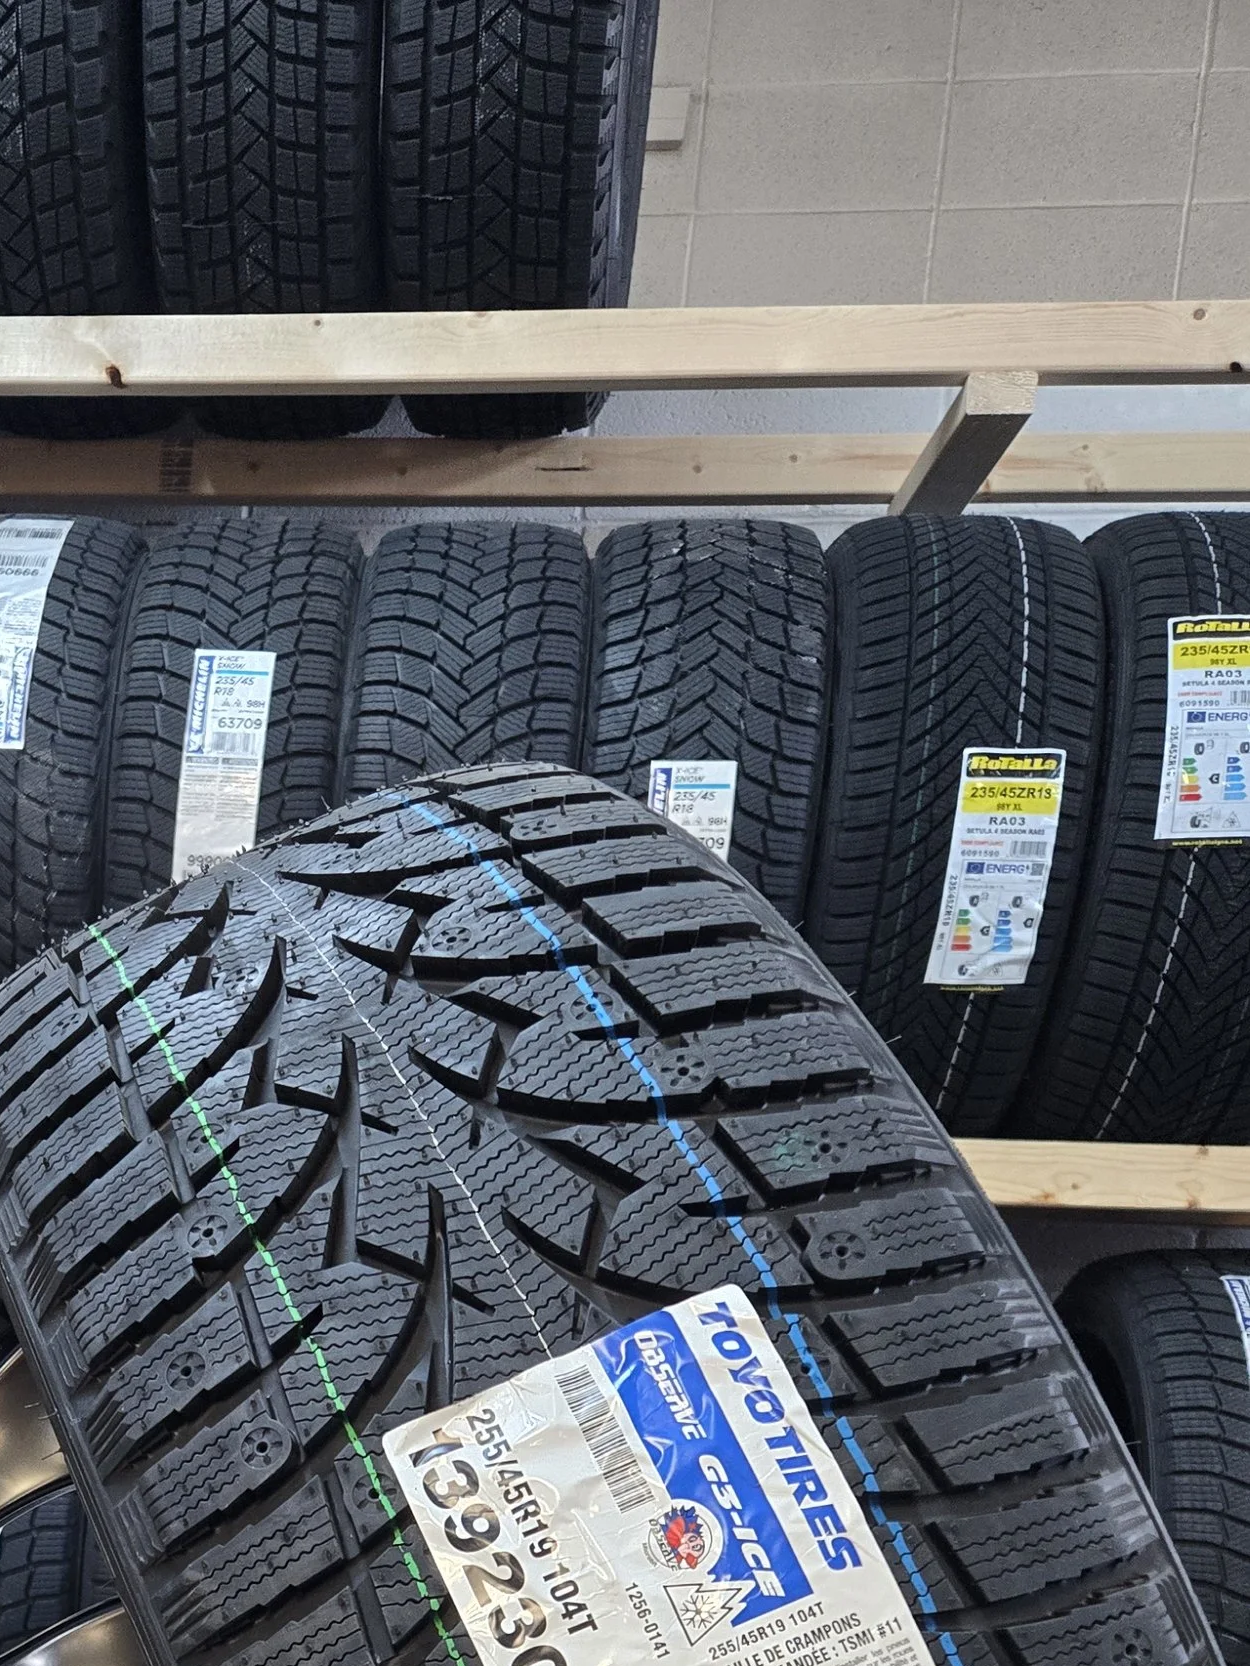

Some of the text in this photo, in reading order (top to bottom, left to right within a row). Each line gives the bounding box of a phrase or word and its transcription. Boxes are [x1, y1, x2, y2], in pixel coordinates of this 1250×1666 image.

[213, 687, 235, 697] R18
[215, 676, 255, 686] 235/45
[1204, 670, 1242, 678] RA03
[191, 658, 210, 732] MICHELIN
[218, 717, 263, 730] 63709
[671, 804, 695, 814] R18
[673, 790, 717, 802] 235/45
[989, 816, 1026, 826] RA03
[701, 1302, 861, 1571] TOYO TIRES
[465, 1408, 599, 1636] 255/45R19 104T
[698, 1454, 785, 1597] G3-ICE
[624, 1582, 671, 1659] 1256-0141
[708, 1601, 824, 1661] 255/45R19 104T
[762, 1644, 786, 1664] DE
[784, 1612, 862, 1655] CRAMPONS
[837, 1627, 876, 1654] TSMI
[876, 1616, 902, 1639] #11
